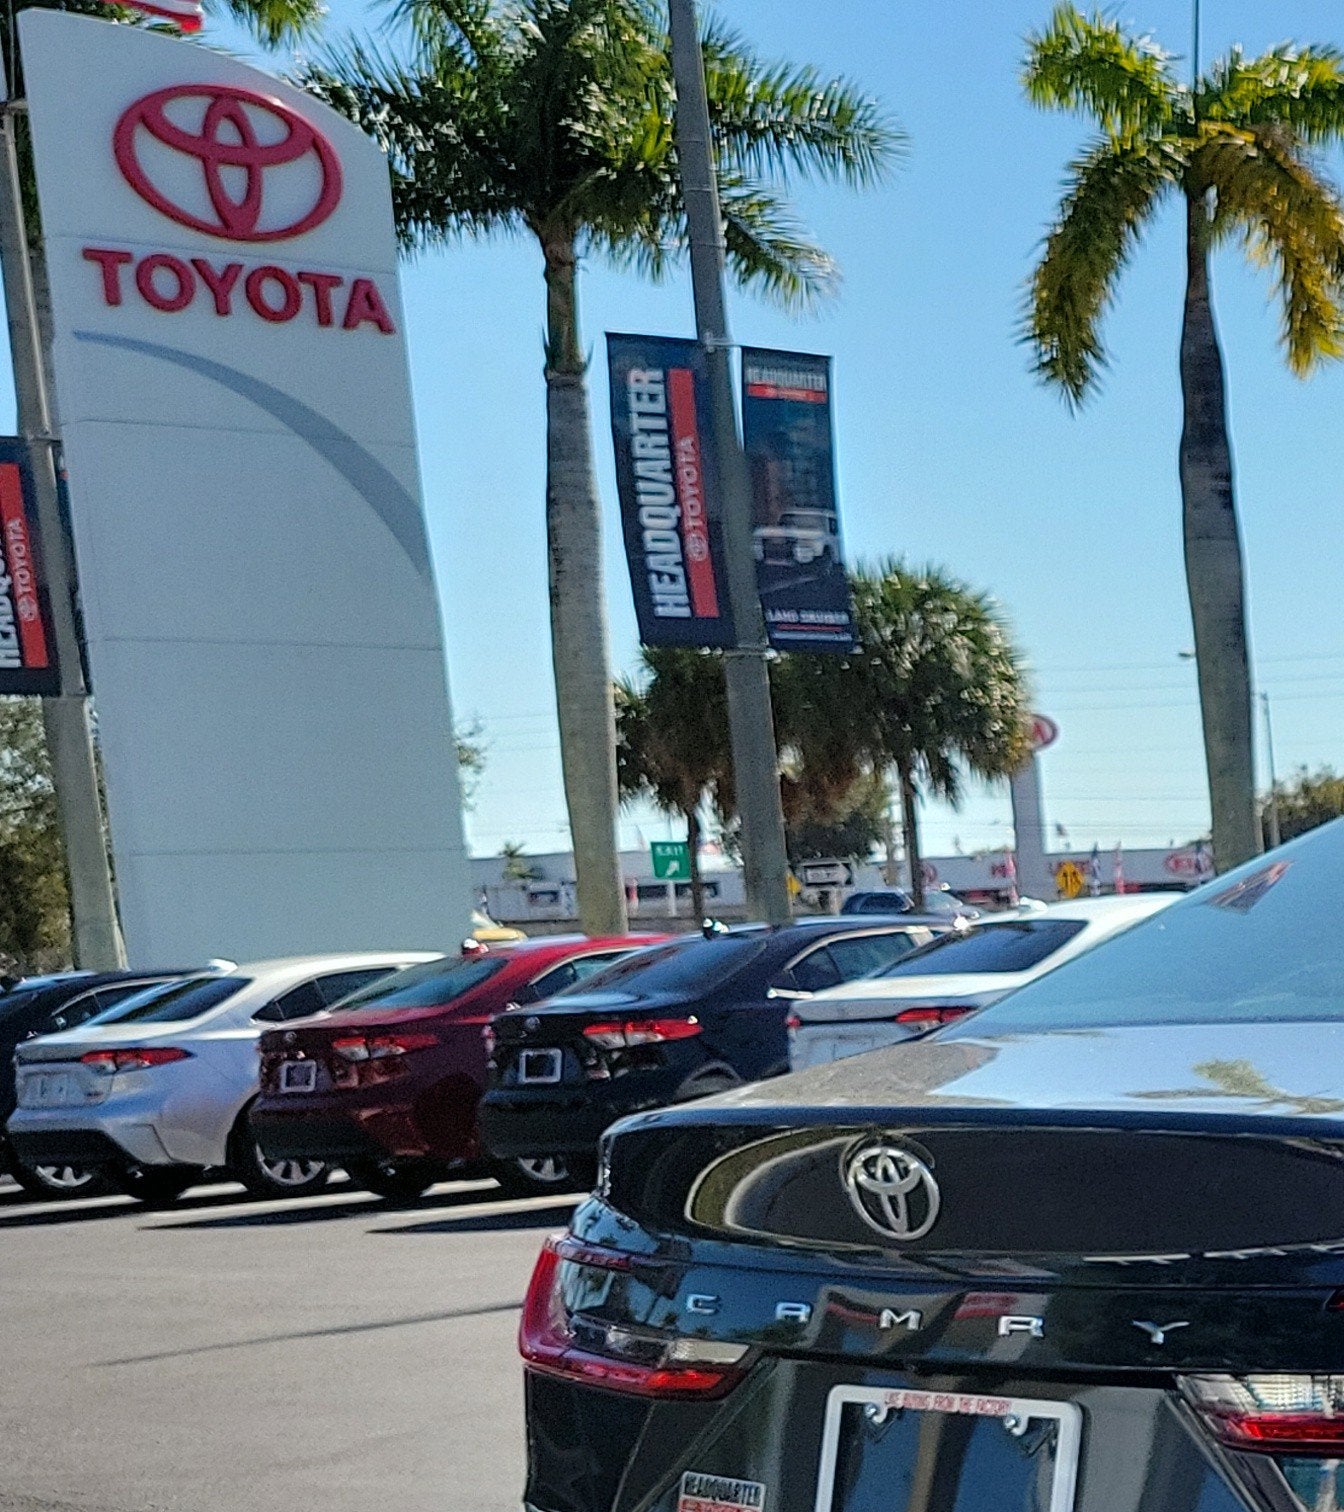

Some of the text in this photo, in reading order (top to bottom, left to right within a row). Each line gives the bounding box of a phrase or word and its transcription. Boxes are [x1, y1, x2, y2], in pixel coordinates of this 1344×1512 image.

[82, 247, 396, 335] TOYOTA
[626, 367, 692, 618] HEADQUARTER
[675, 435, 704, 529] TOYOTA
[6, 518, 33, 594] TOYOTA
[685, 1292, 1190, 1345] CAMRY
[683, 1473, 761, 1507] HEADQUARTER
